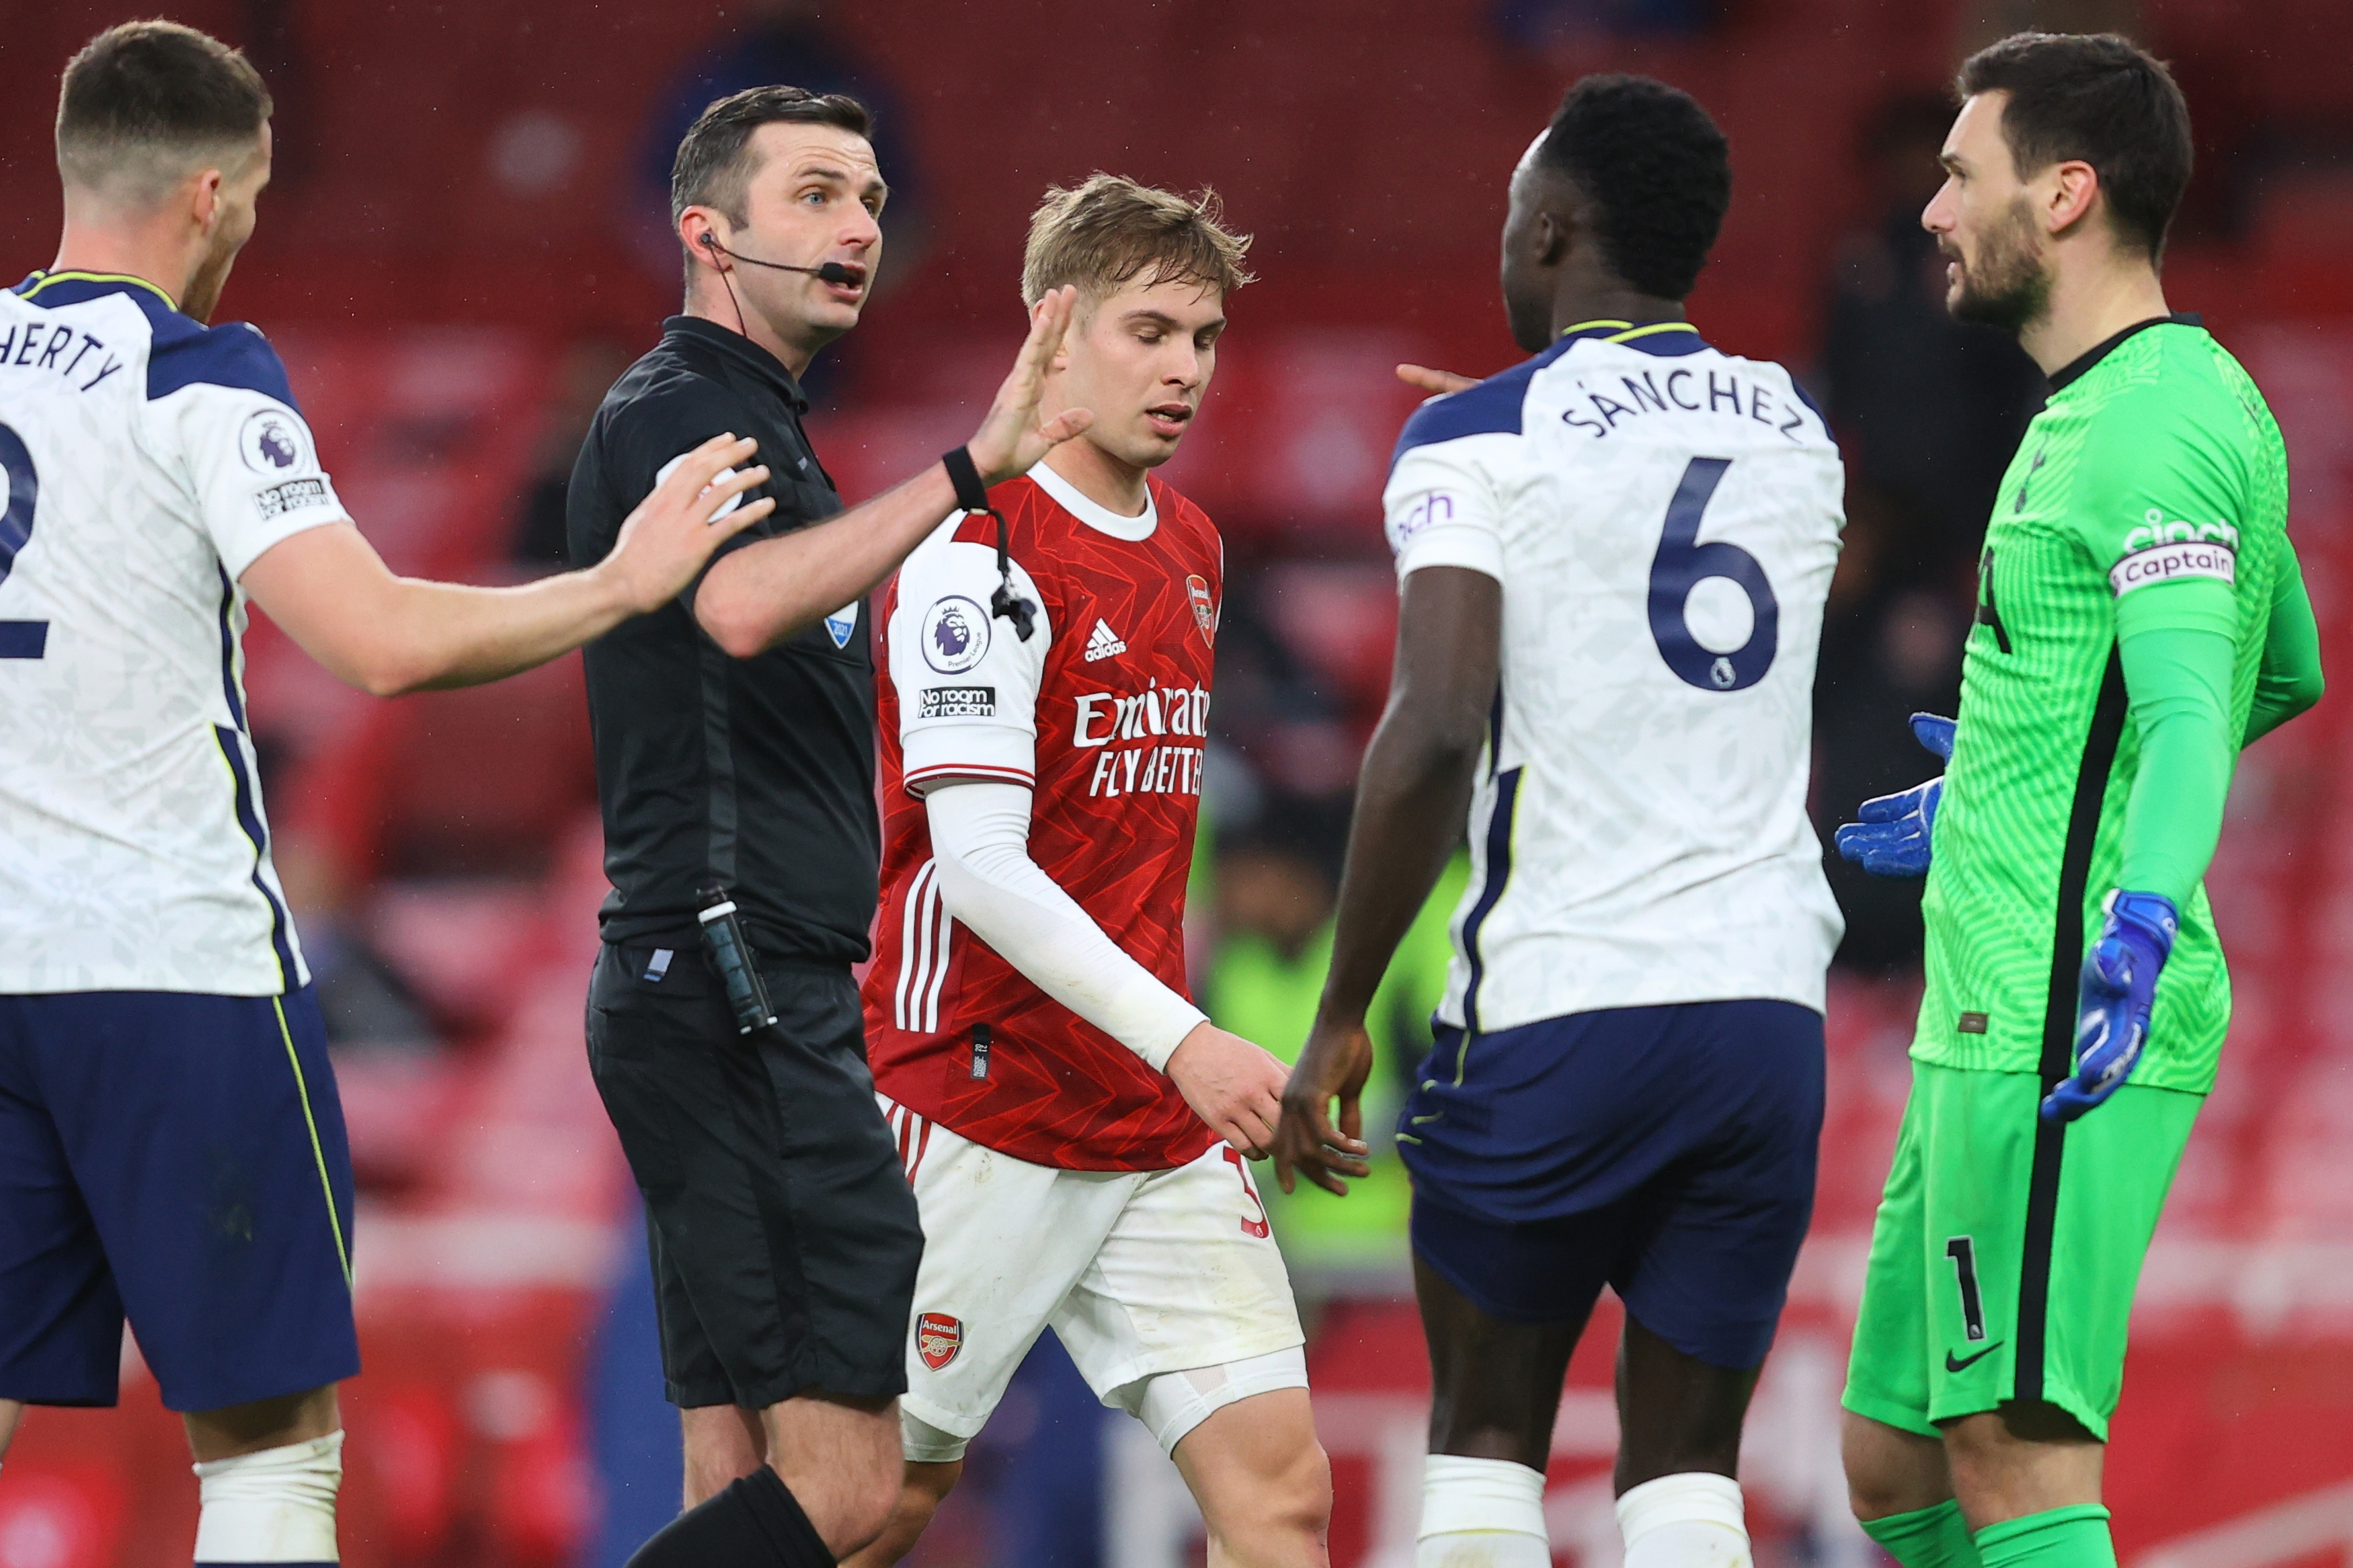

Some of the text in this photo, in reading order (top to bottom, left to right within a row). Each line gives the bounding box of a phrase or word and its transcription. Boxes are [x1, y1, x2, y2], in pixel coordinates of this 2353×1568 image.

[1562, 370, 1804, 443] SÁNCHEZ
[1648, 456, 1778, 691] 6
[2126, 550, 2231, 582] Captain
[948, 632, 982, 667] Premier League
[1084, 640, 1127, 663] adidas
[918, 702, 995, 718] for racism
[920, 689, 988, 706] No room
[1089, 748, 1142, 797] FLY
[1944, 1235, 1987, 1342] 1
[922, 1319, 957, 1335] Arsenal
